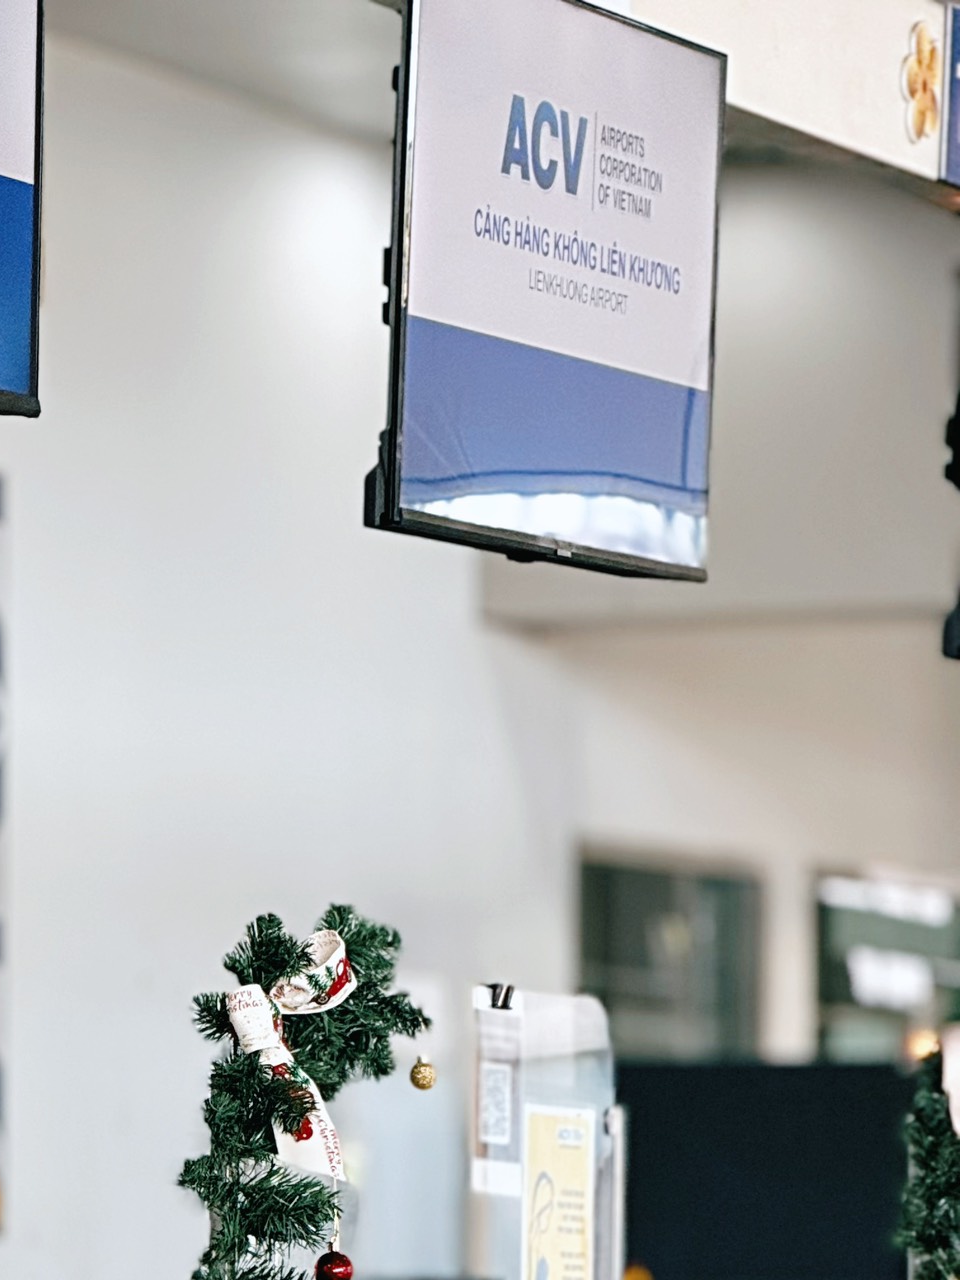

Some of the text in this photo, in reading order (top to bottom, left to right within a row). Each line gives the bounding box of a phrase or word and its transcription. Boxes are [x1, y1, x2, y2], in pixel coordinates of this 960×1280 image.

[501, 94, 588, 196] ACV
[600, 125, 645, 158] AIRPORTS
[599, 154, 663, 193] CORPORATION
[598, 183, 652, 219] OF VIETNAM
[474, 204, 681, 294] CẢNG HÀNG KHÔNG LIÊN KHƯƠNG
[528, 268, 628, 314] LIENKHUONG AIRPORT
